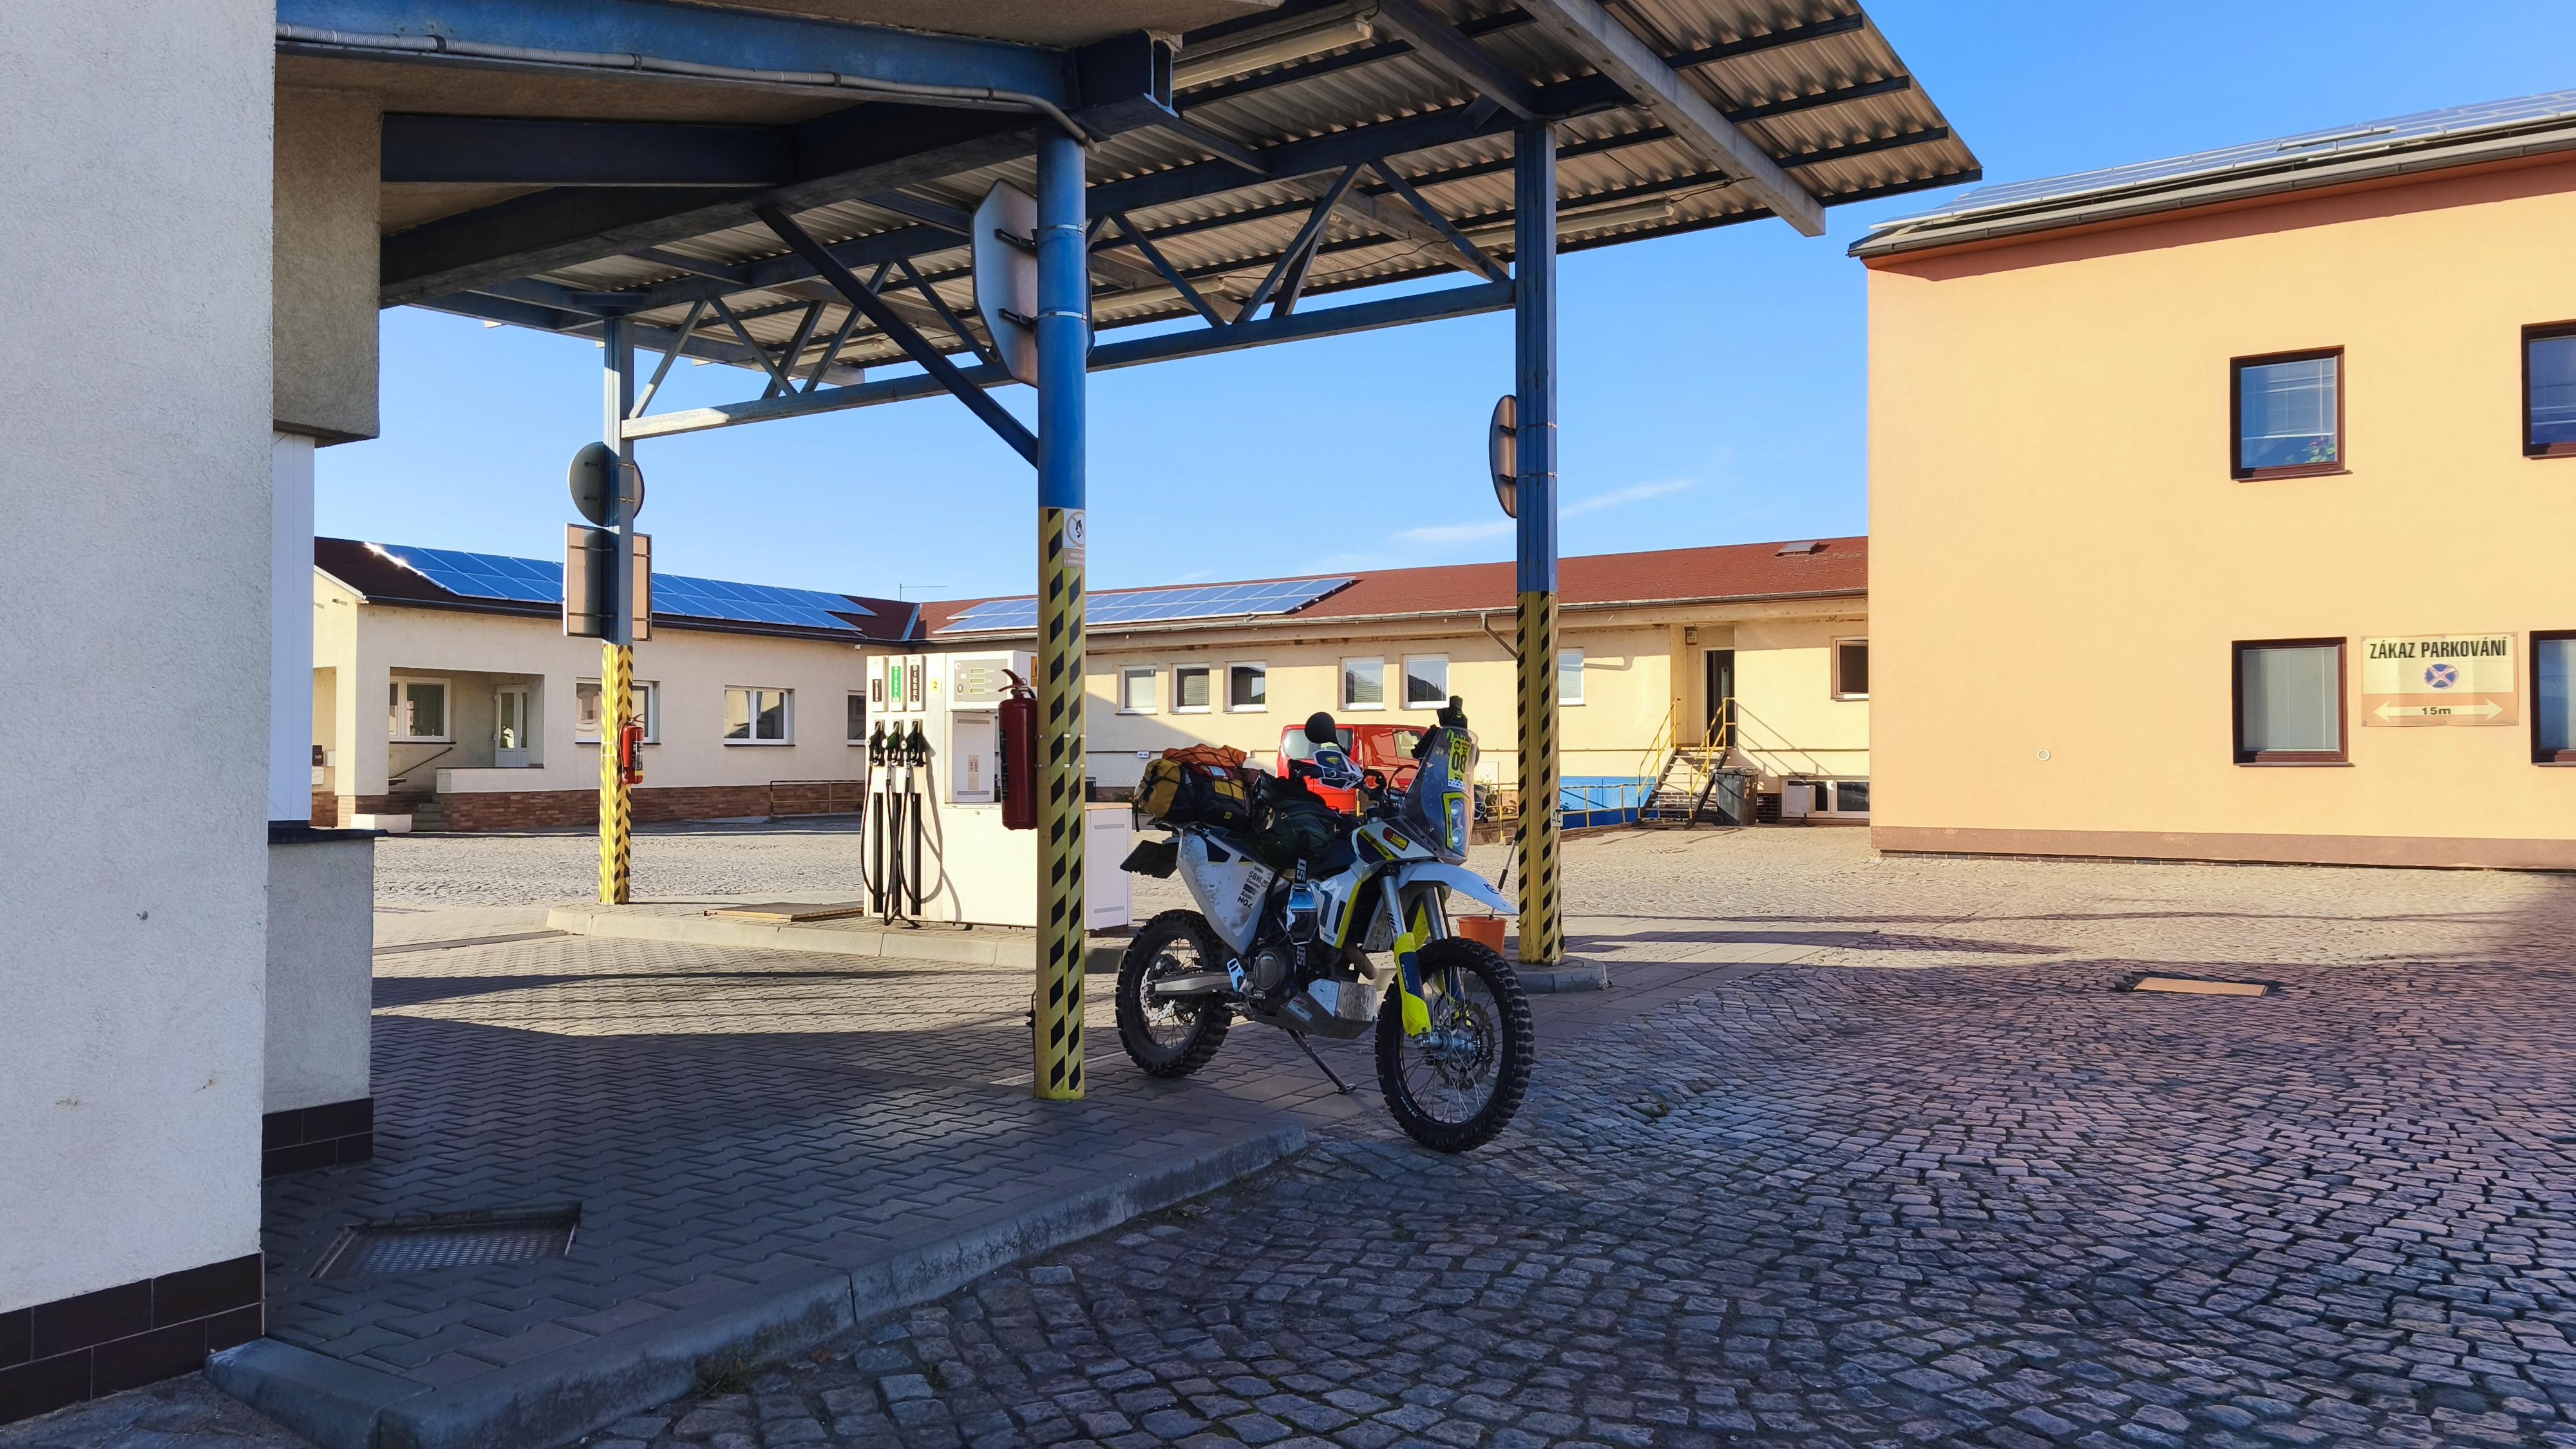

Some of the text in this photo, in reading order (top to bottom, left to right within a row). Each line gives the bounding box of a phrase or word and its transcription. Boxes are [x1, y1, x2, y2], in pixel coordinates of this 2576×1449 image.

[2370, 637, 2507, 659] ZÁKAZ PARKOVÁNÍ
[1451, 752, 1467, 773] 08
[1238, 896, 1253, 910] NGK
